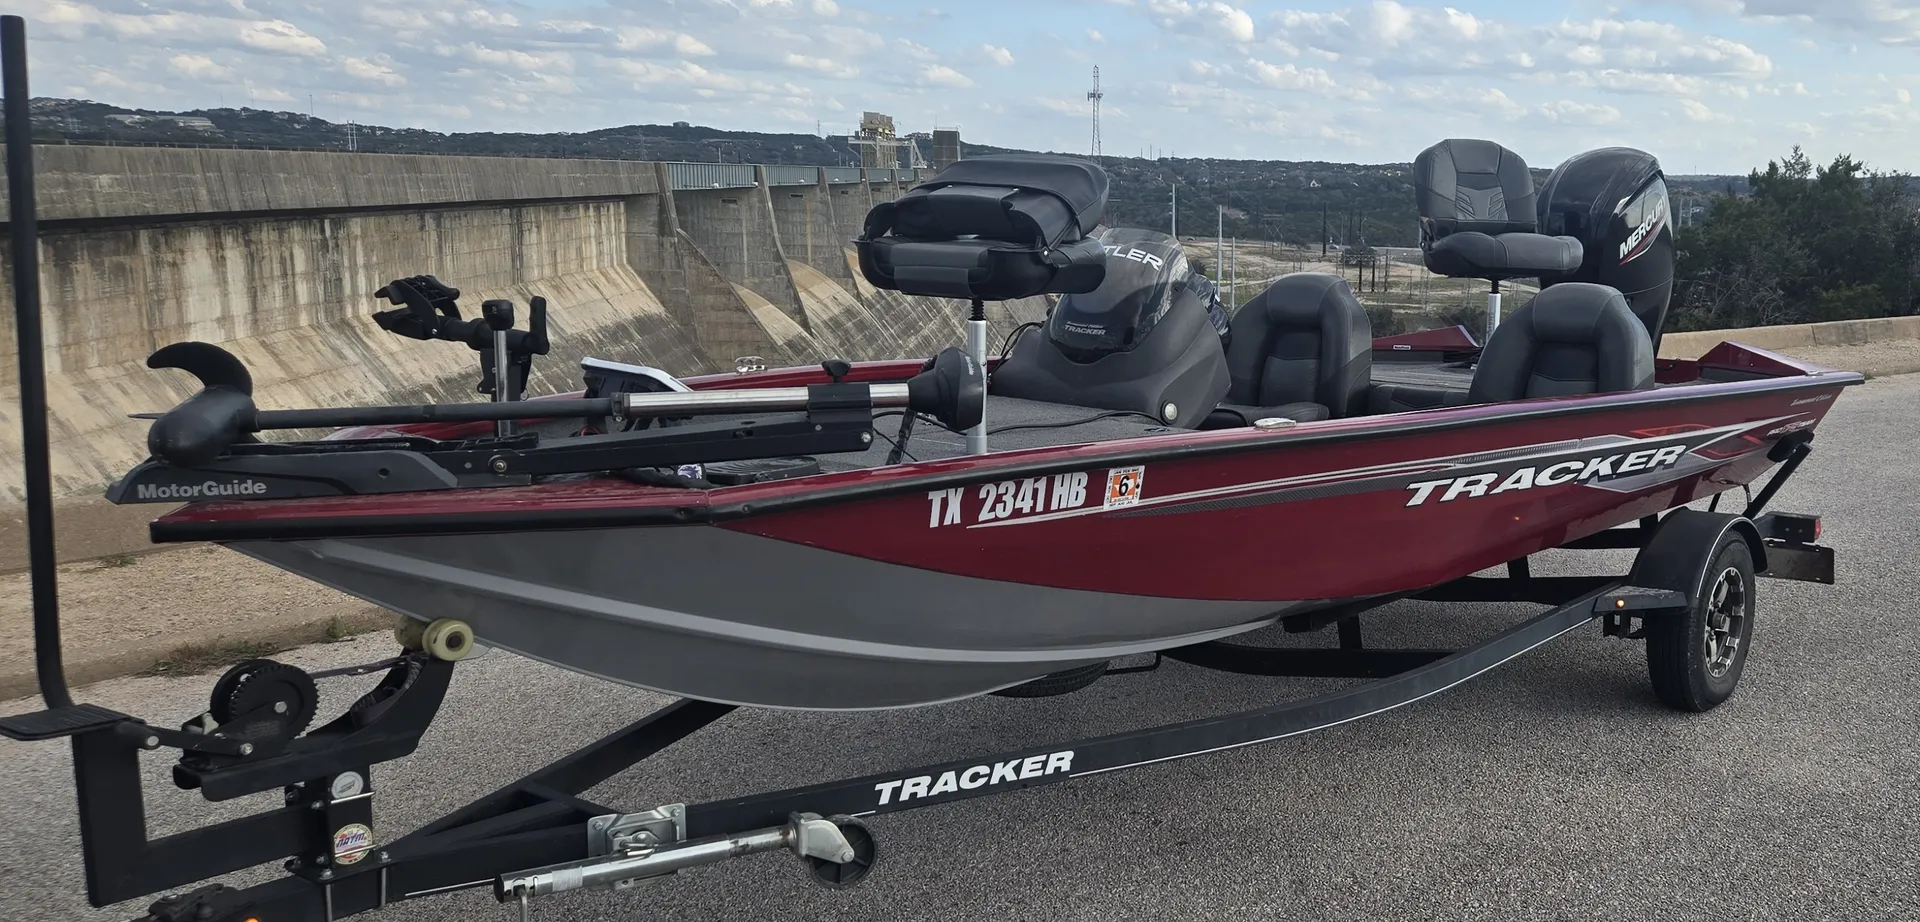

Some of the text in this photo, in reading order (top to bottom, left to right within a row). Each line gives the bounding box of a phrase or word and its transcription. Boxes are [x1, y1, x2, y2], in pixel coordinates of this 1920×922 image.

[1065, 324, 1106, 335] TRACKER
[137, 480, 267, 499] MotorGuide
[1118, 475, 1130, 496] 6
[1405, 445, 1687, 507] TRACKER
[928, 487, 964, 528] TX
[978, 476, 1047, 522] 2341
[1050, 472, 1088, 511] HB
[874, 750, 1075, 806] TRACKER
